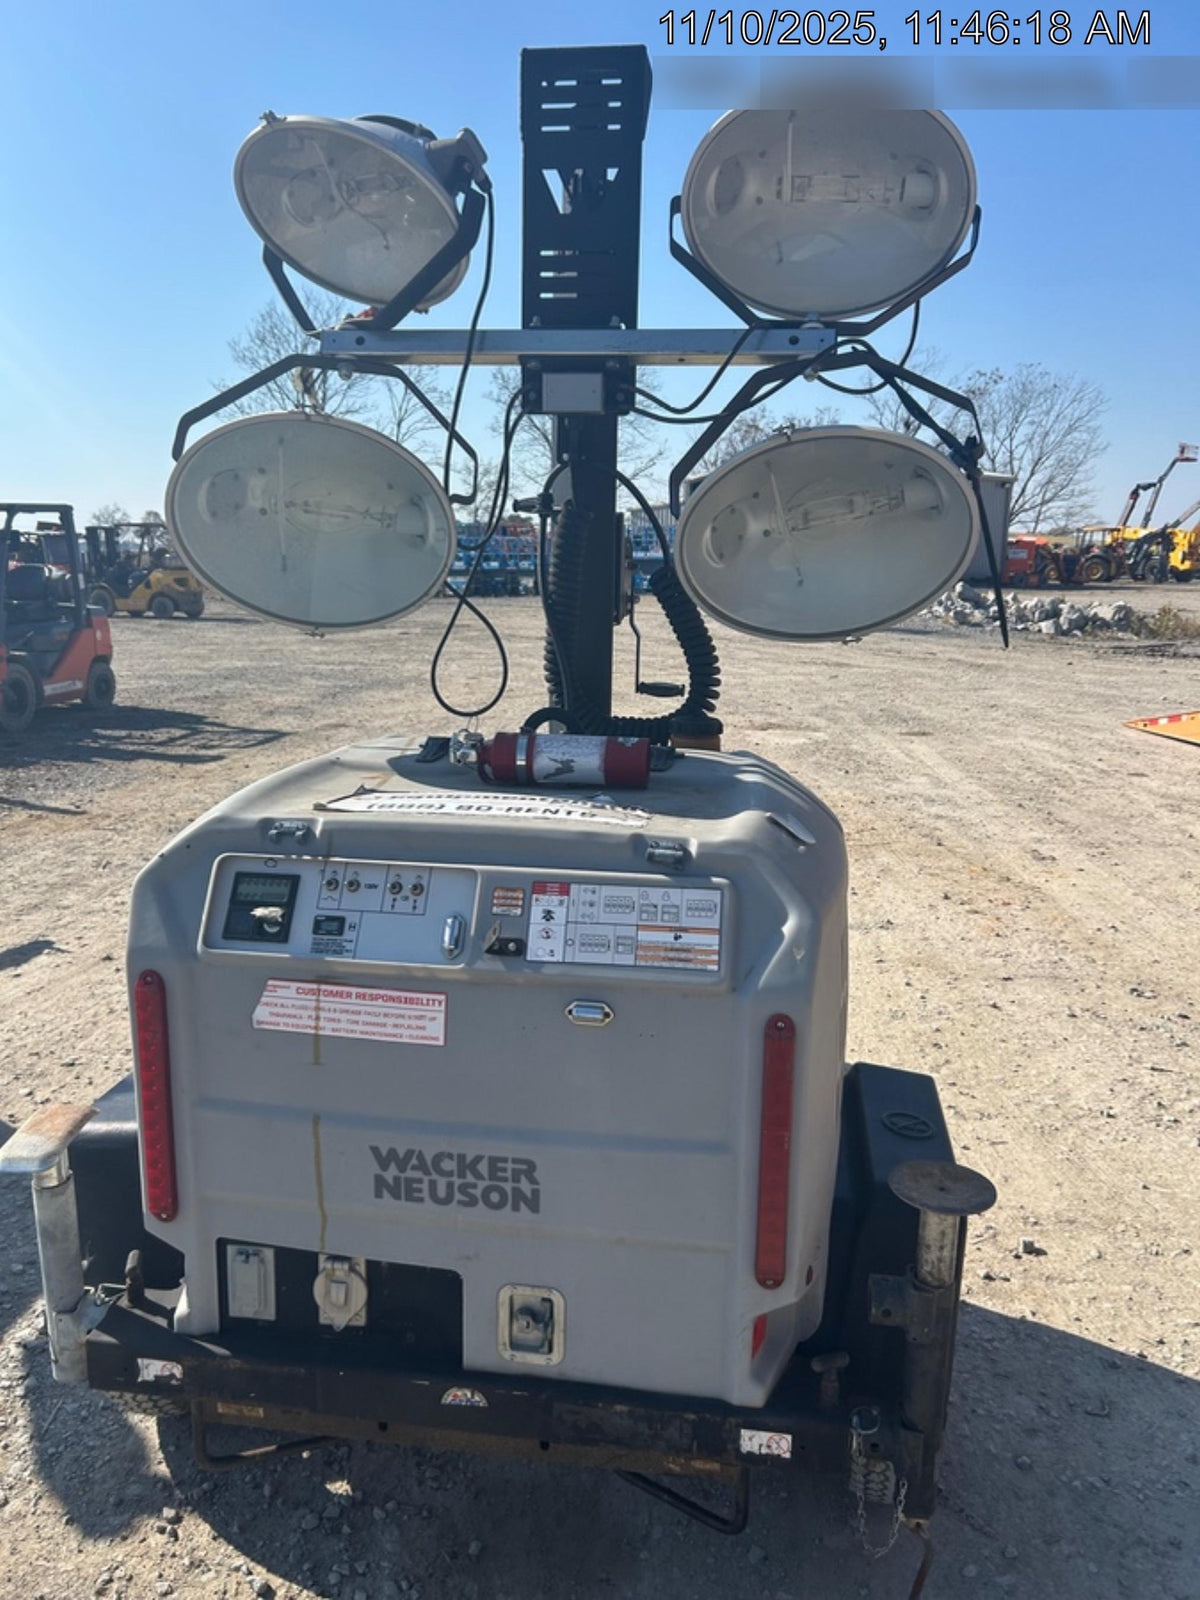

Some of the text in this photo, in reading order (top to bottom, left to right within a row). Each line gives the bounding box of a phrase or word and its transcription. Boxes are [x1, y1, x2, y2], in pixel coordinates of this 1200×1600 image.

[295, 986, 353, 999] CUSTOMER
[355, 991, 443, 1007] RESPONSIBILITY
[368, 1145, 541, 1186] WACKER
[374, 1173, 541, 1215] NEUSON
